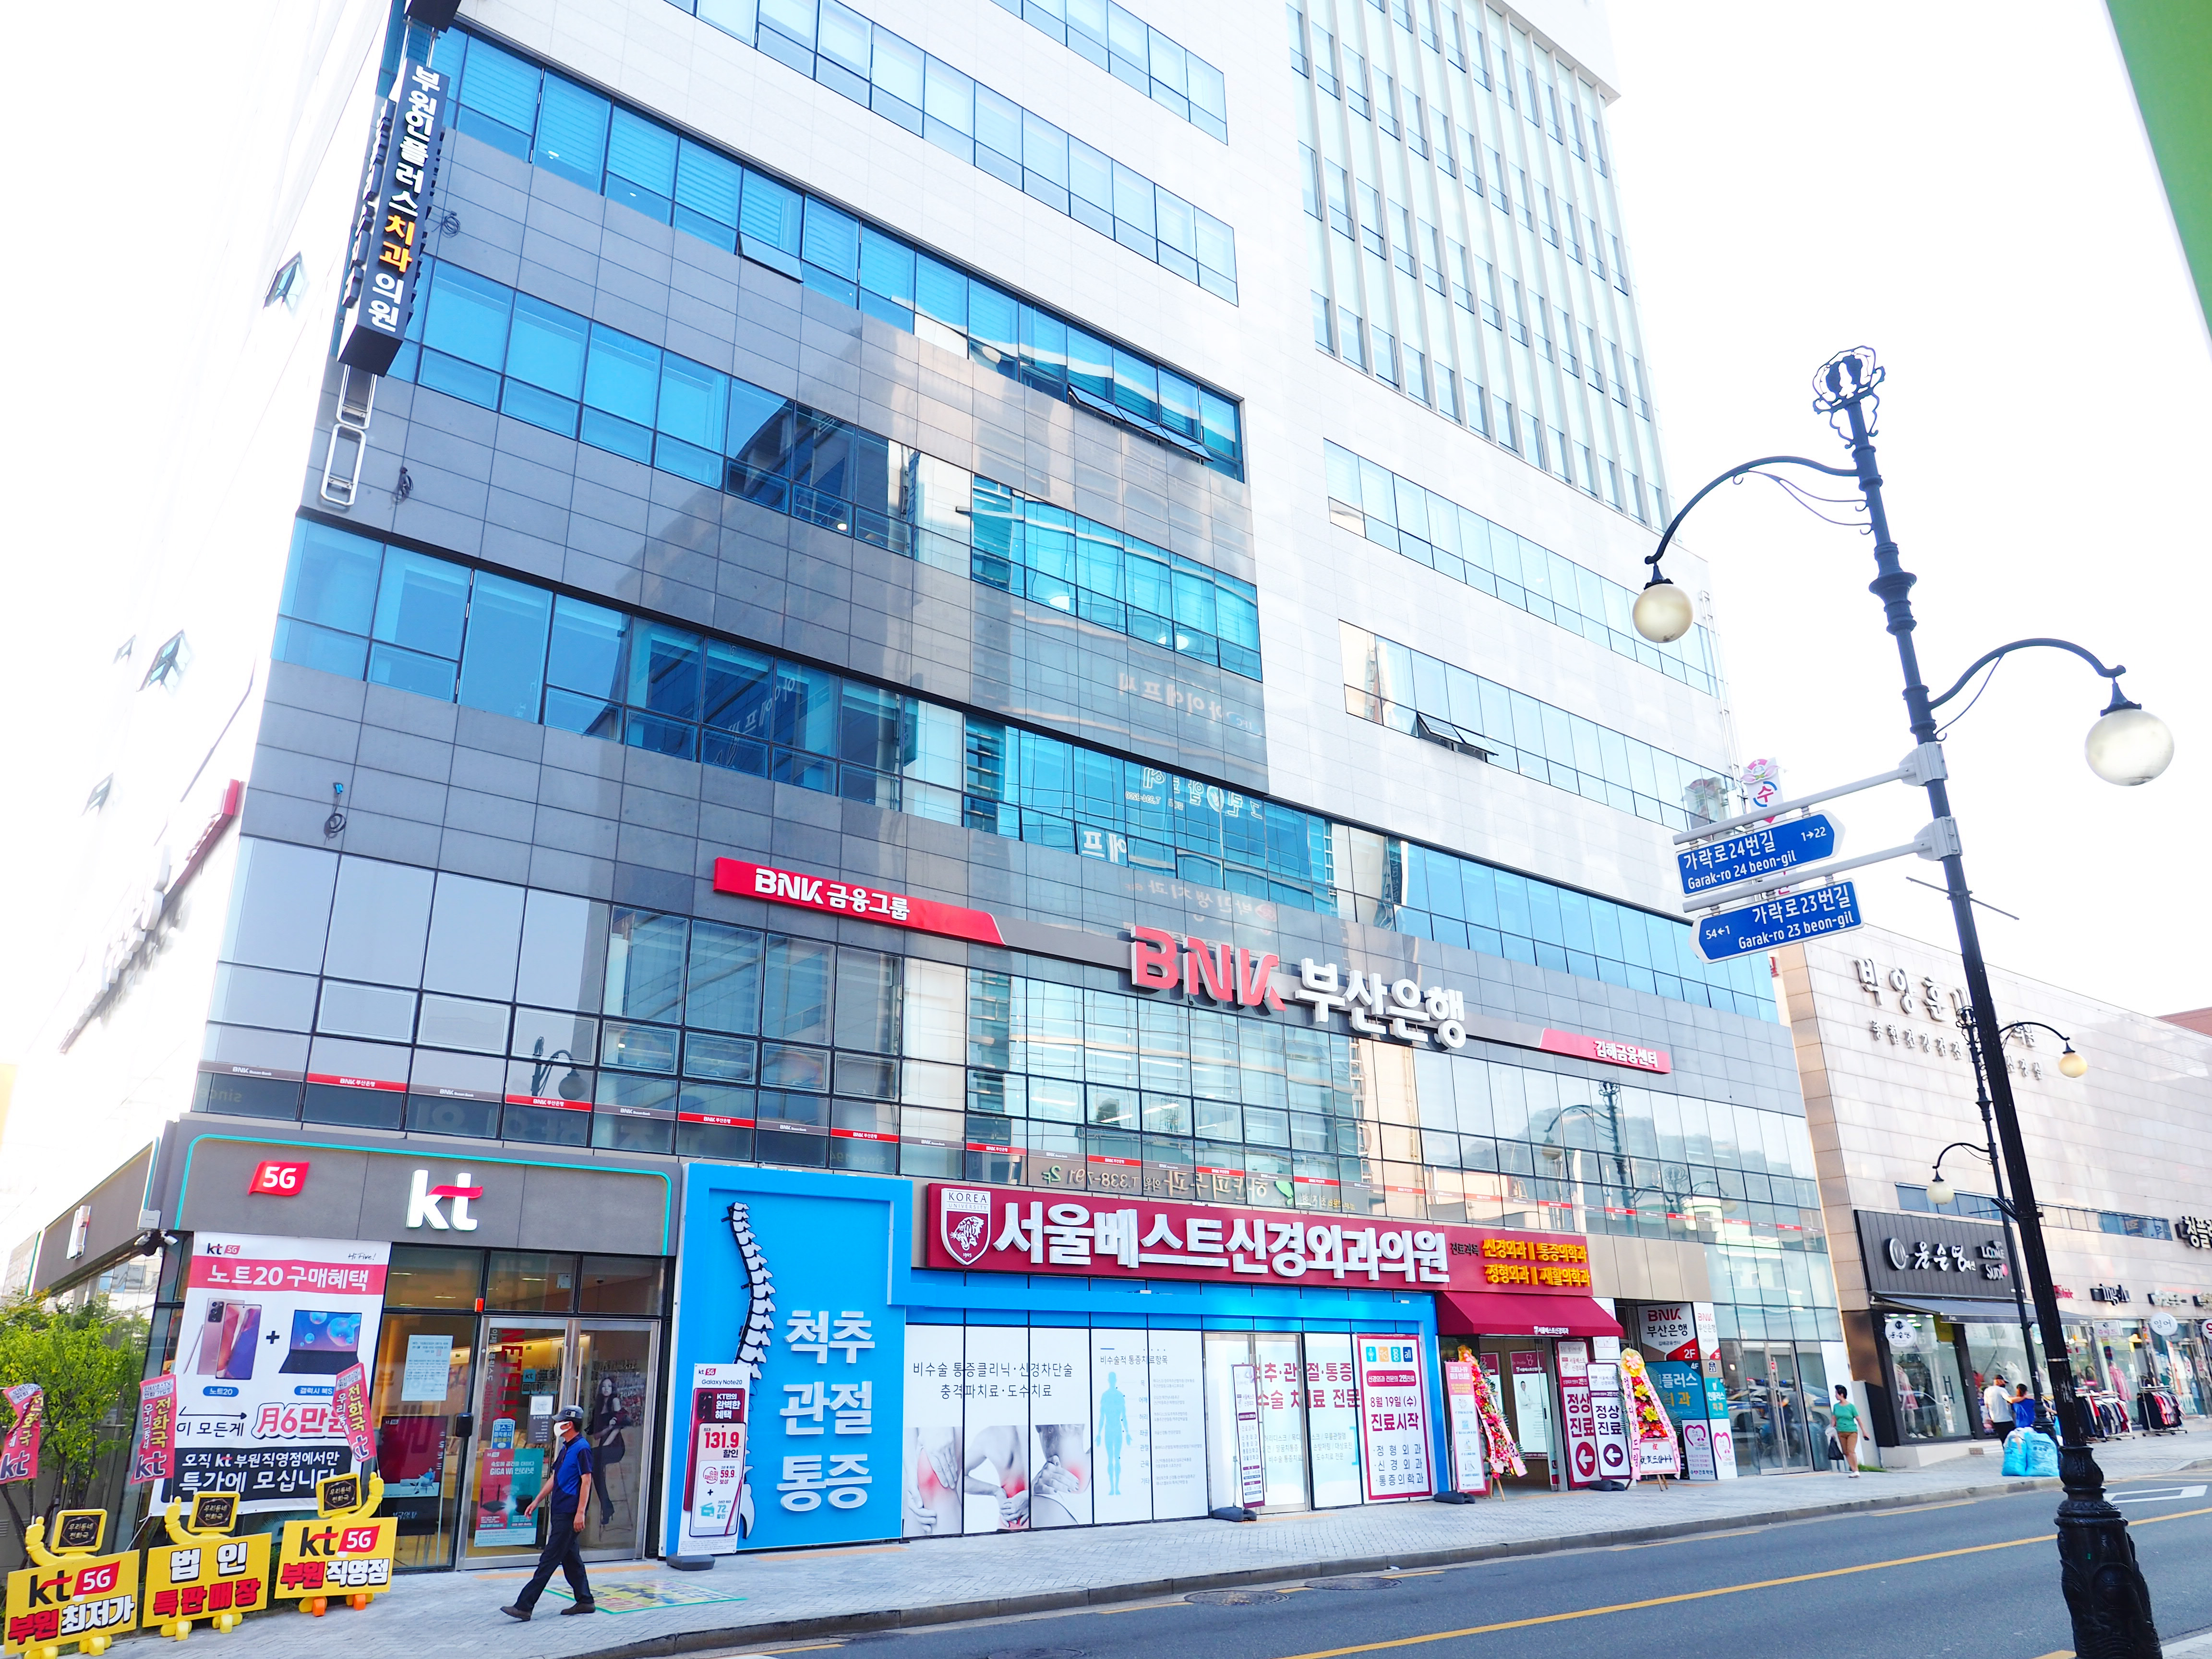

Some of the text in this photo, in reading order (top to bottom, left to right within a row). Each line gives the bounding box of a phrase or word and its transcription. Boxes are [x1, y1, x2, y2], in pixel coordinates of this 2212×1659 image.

[1683, 830, 1776, 871] 가락로24번길
[1688, 849, 1797, 890] Garak-ro 24 beon-gil
[755, 867, 910, 922] BNK 금융그룹
[1752, 884, 1851, 925] 가락로23번길
[1738, 910, 1854, 950] Garak-ro 23 beon-gil
[1130, 926, 1467, 1049] BNK 부산은행
[1593, 1040, 1659, 1068] 김해금융센터
[262, 1166, 297, 1190] 5G
[405, 1168, 483, 1232] kt
[949, 1191, 987, 1204] KOREA
[206, 1242, 223, 1255] kt
[992, 1200, 1450, 1283] 서울베스트신경외과의원
[1482, 1238, 1527, 1260] 신경외과
[1536, 1242, 1587, 1263] 통증의학과
[358, 1252, 376, 1261] Five!
[207, 1264, 369, 1292] 노트20 구매혜택
[1484, 1263, 1590, 1287] 정형외과 재활의학과
[1647, 1308, 1682, 1322] BNK
[783, 1310, 876, 1364] 척추
[1647, 1323, 1688, 1338] 부산은행
[1100, 1355, 1127, 1365] 비수술적
[1683, 1348, 1696, 1359] 2F
[913, 1361, 949, 1377] 비수술
[1256, 1362, 1352, 1383] 추·관절·통증
[208, 1388, 233, 1396] 노트20
[300, 1386, 320, 1395] 갤럭시
[1333, 1388, 1360, 1408] 전문
[348, 1383, 366, 1432] 전화국
[716, 1400, 741, 1410] 완벽한
[779, 1381, 873, 1436] 관절
[1370, 1395, 1417, 1408] 8월 19일 (수)
[1567, 1394, 1591, 1414] 정상
[715, 1410, 732, 1419] 혜택
[1370, 1412, 1419, 1432] 진료시작
[1595, 1405, 1620, 1419] 정상
[150, 1397, 171, 1448] 전화국
[177, 1421, 245, 1438] 이 모든게
[1570, 1417, 1595, 1438] 진료
[1598, 1421, 1623, 1436] 진료
[705, 1431, 740, 1449] 131.9
[182, 1453, 212, 1469] 오직
[215, 1453, 233, 1467] kt
[723, 1449, 739, 1458] 할인
[0, 1451, 30, 1480] kt
[134, 1451, 167, 1480] kt
[720, 1469, 735, 1479] 59.9
[179, 1471, 247, 1493] 특가에
[329, 1485, 352, 1496] 우리동네
[777, 1453, 873, 1512] 통증
[331, 1493, 350, 1503] 전화국
[203, 1504, 227, 1513] 우리동네
[204, 1513, 224, 1521] 전화국
[299, 1526, 372, 1557] kt 5G
[280, 1558, 390, 1590] 부원 직영점
[29, 1567, 111, 1608] kt 5G
[8, 1594, 135, 1646] 부원 최저가
